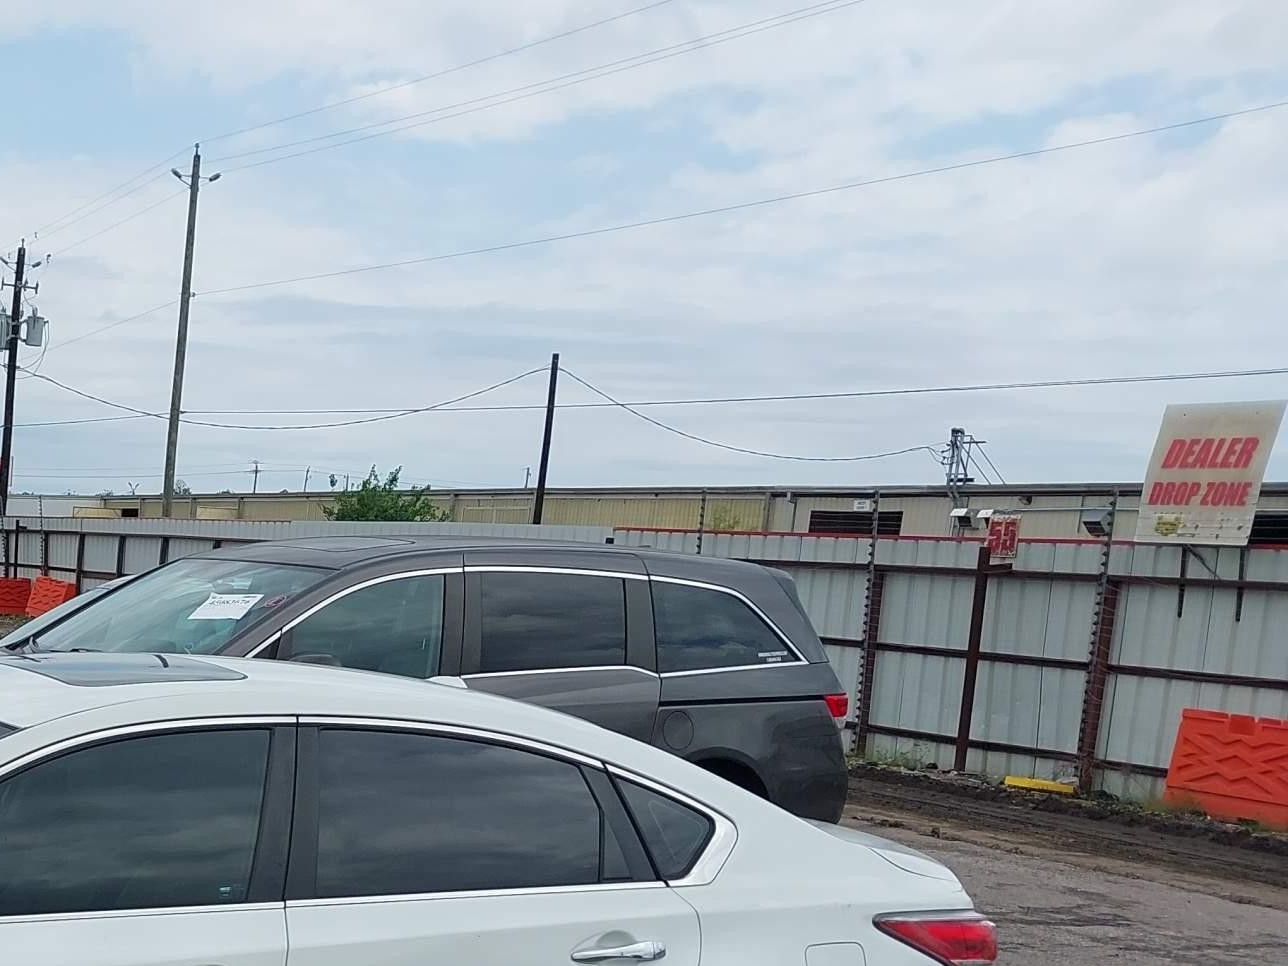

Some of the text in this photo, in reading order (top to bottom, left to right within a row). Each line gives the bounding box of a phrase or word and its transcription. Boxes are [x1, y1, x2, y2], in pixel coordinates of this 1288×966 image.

[1161, 436, 1260, 471] DEALER
[1148, 481, 1253, 507] DROP ZONE
[988, 521, 1017, 554] 55
